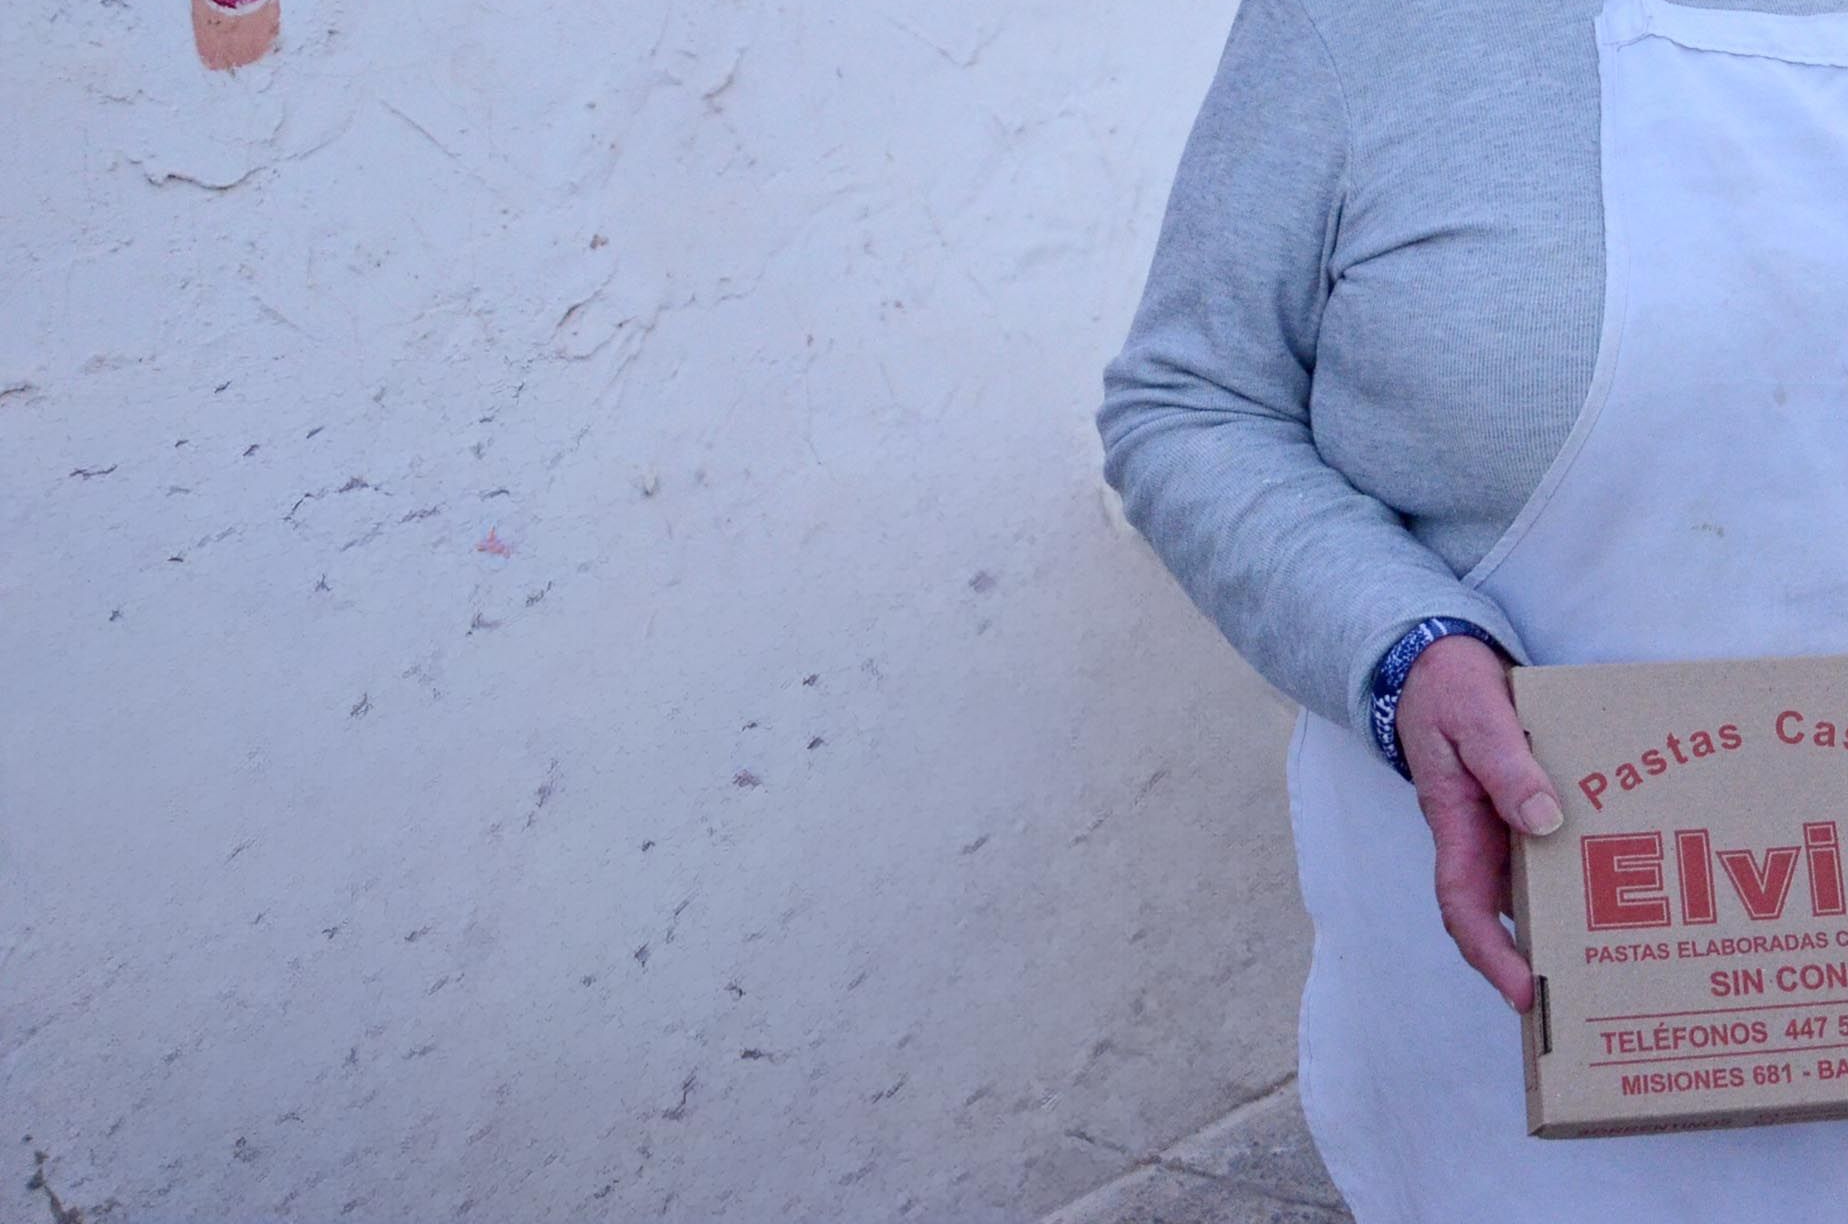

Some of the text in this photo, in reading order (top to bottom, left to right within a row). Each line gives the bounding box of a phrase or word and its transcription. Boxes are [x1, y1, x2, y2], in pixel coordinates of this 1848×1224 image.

[1578, 723, 1743, 811] Pastas
[1585, 943, 1670, 964] PASTAS
[1677, 932, 1829, 959] ELABORADAS
[1710, 967, 1765, 997] SIN
[1600, 1022, 1768, 1055] TELÉFONOS
[1784, 1016, 1828, 1041] 447
[1621, 1067, 1745, 1096] MISIONES
[1752, 1063, 1792, 1085] 681
